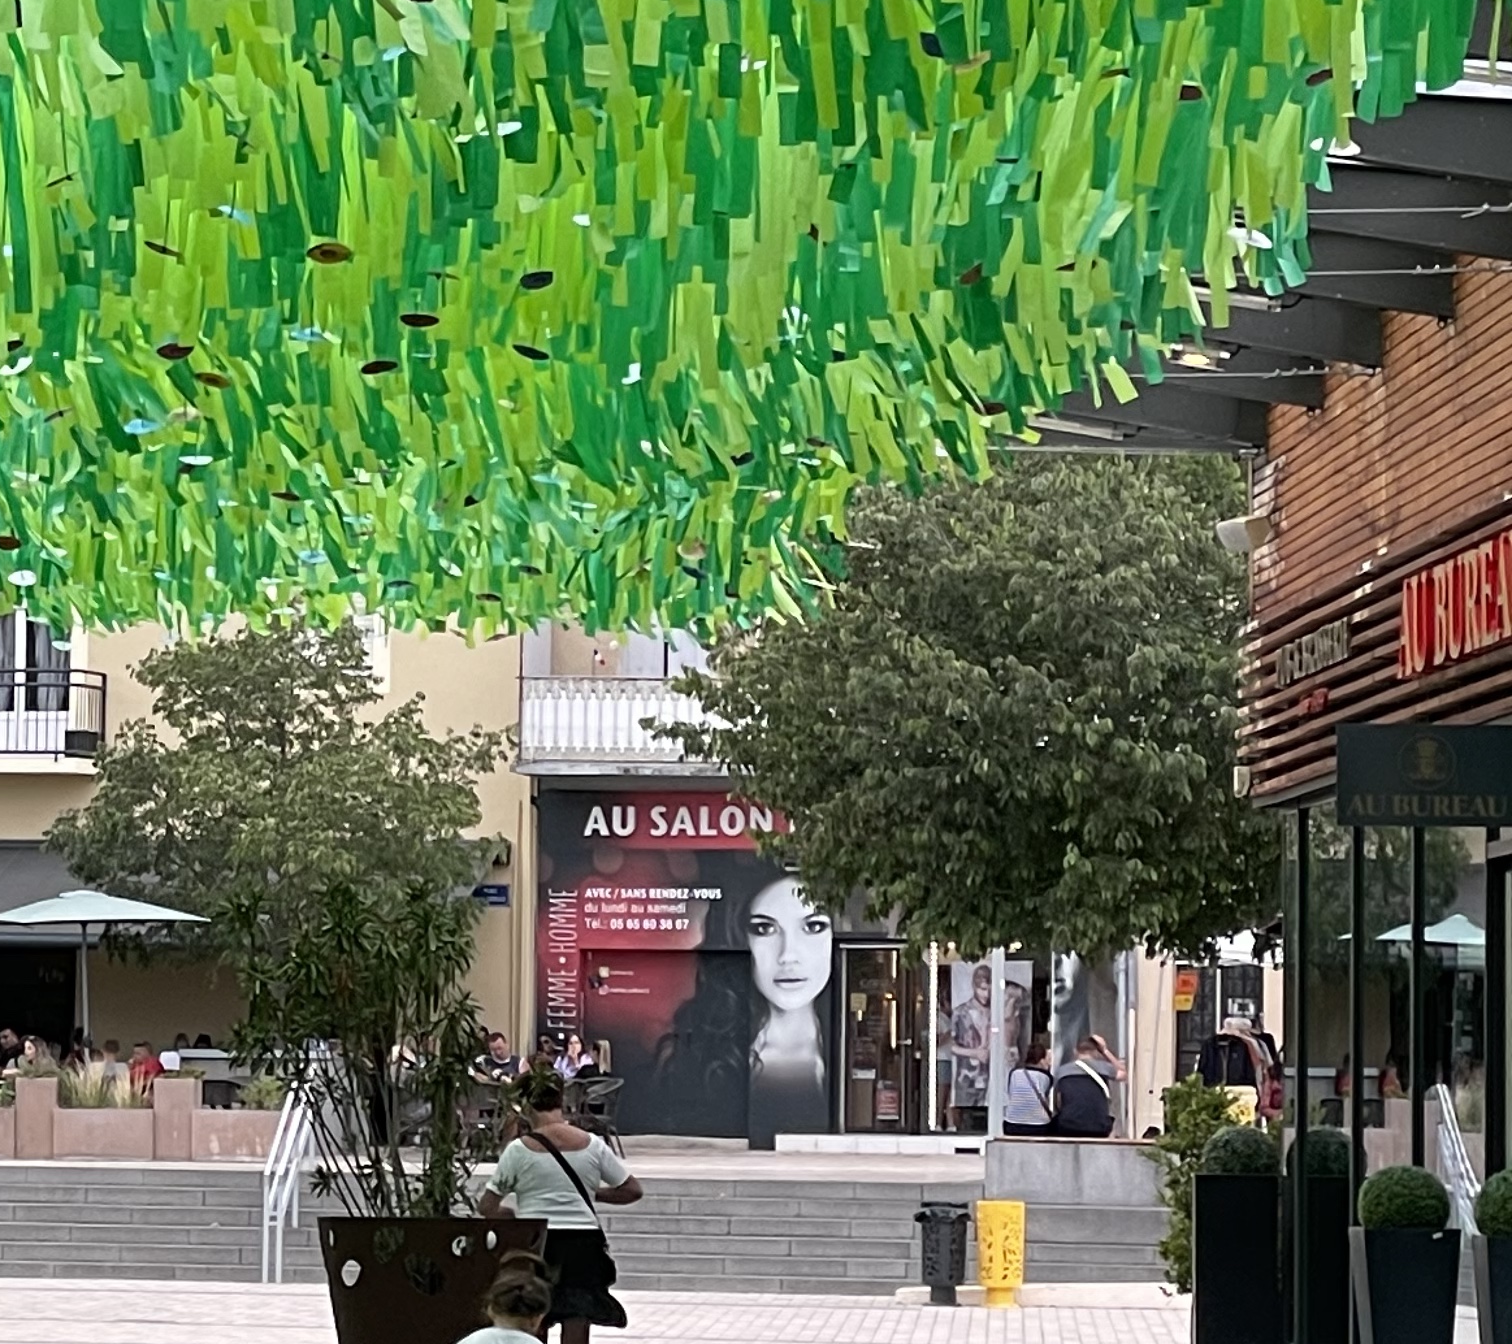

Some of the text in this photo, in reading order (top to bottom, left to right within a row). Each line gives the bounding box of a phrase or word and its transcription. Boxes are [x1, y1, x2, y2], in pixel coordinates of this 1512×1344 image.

[1397, 570, 1428, 679] AU
[1433, 530, 1512, 666] BUREA
[1346, 794, 1507, 817] AU BUREAU
[584, 806, 636, 836] AU
[650, 806, 773, 836] SALON
[585, 888, 612, 899] AVEC
[621, 888, 647, 899] SANS
[649, 888, 722, 899] RENDEZ-VOUS
[548, 888, 578, 953] HOMME
[584, 902, 686, 913] du lundi au samedi
[610, 918, 624, 930] 05
[547, 968, 577, 1029] FEMME
